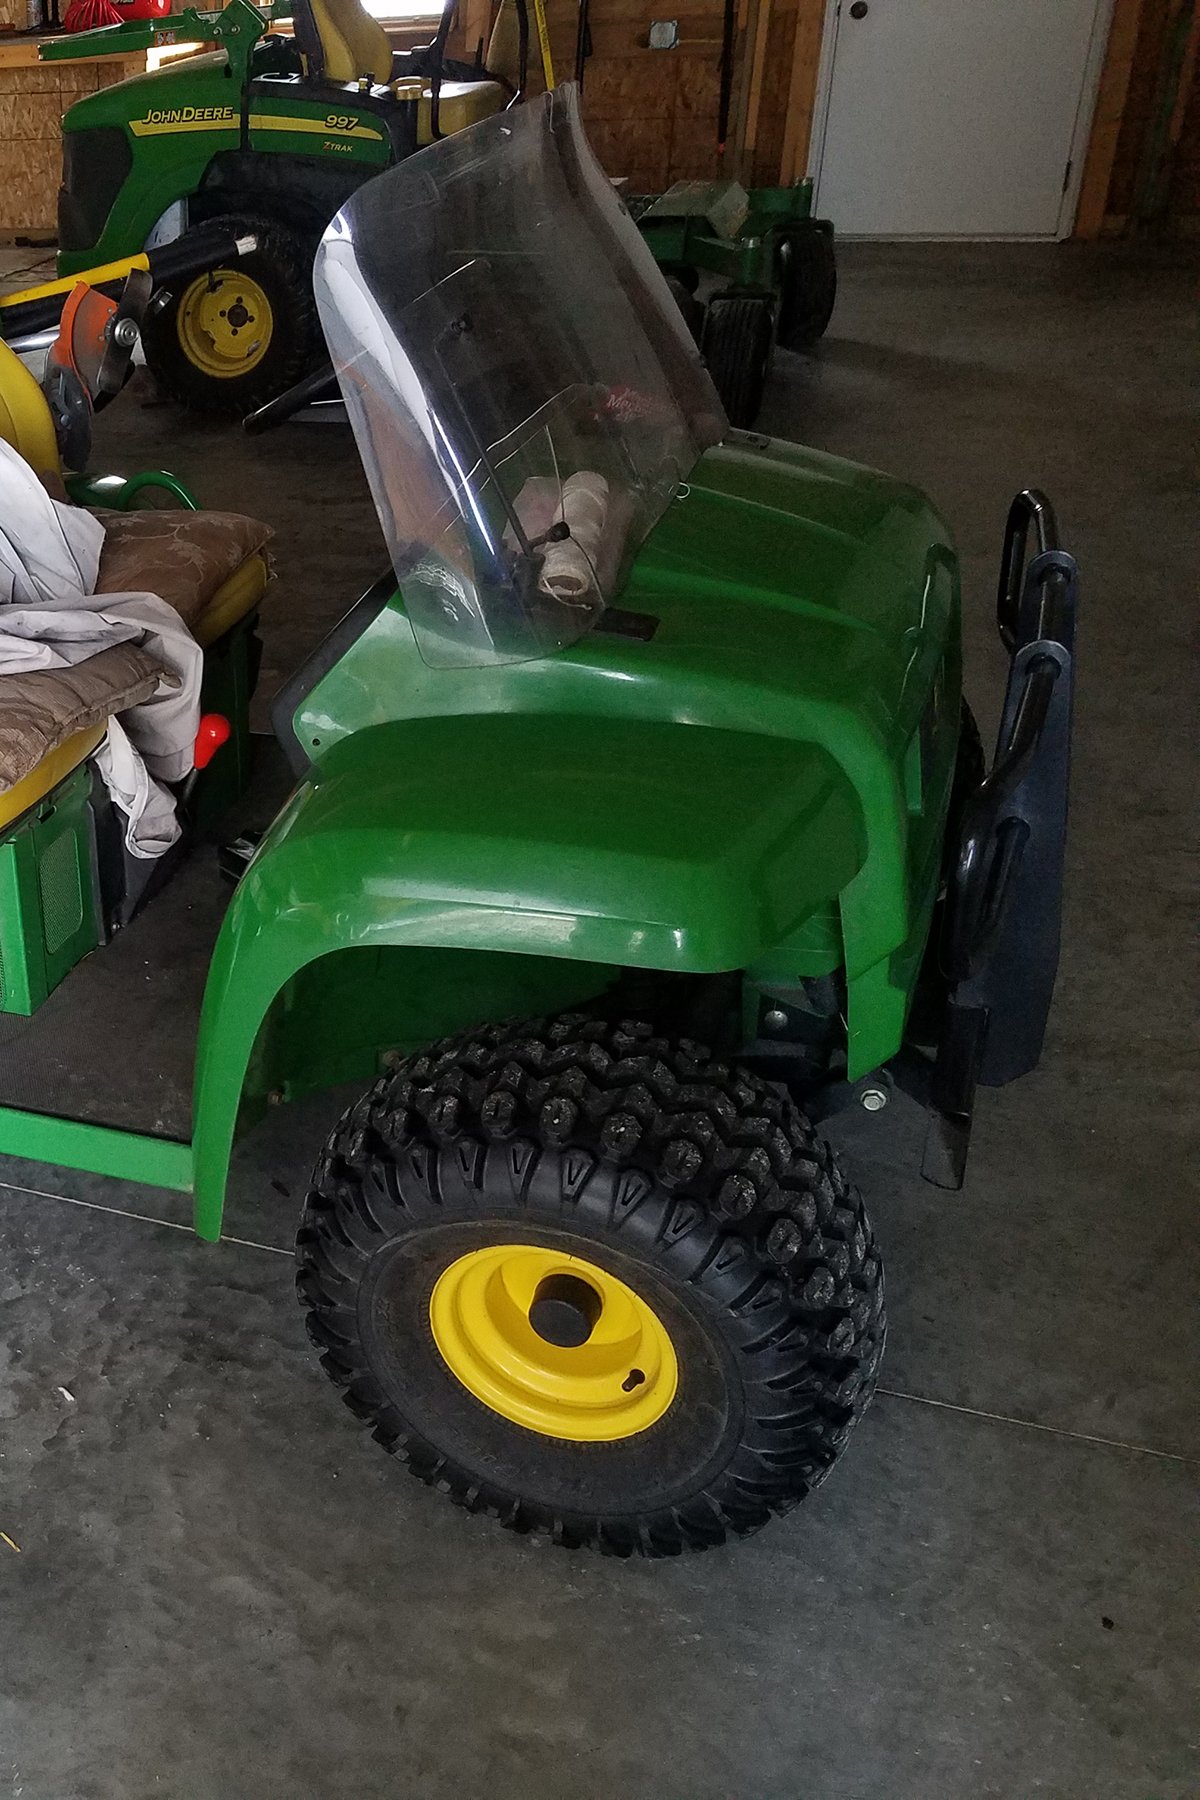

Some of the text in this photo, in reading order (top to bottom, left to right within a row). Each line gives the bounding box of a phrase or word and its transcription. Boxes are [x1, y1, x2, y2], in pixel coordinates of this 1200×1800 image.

[142, 106, 234, 124] JOHN DEERE
[325, 114, 359, 130] 997
